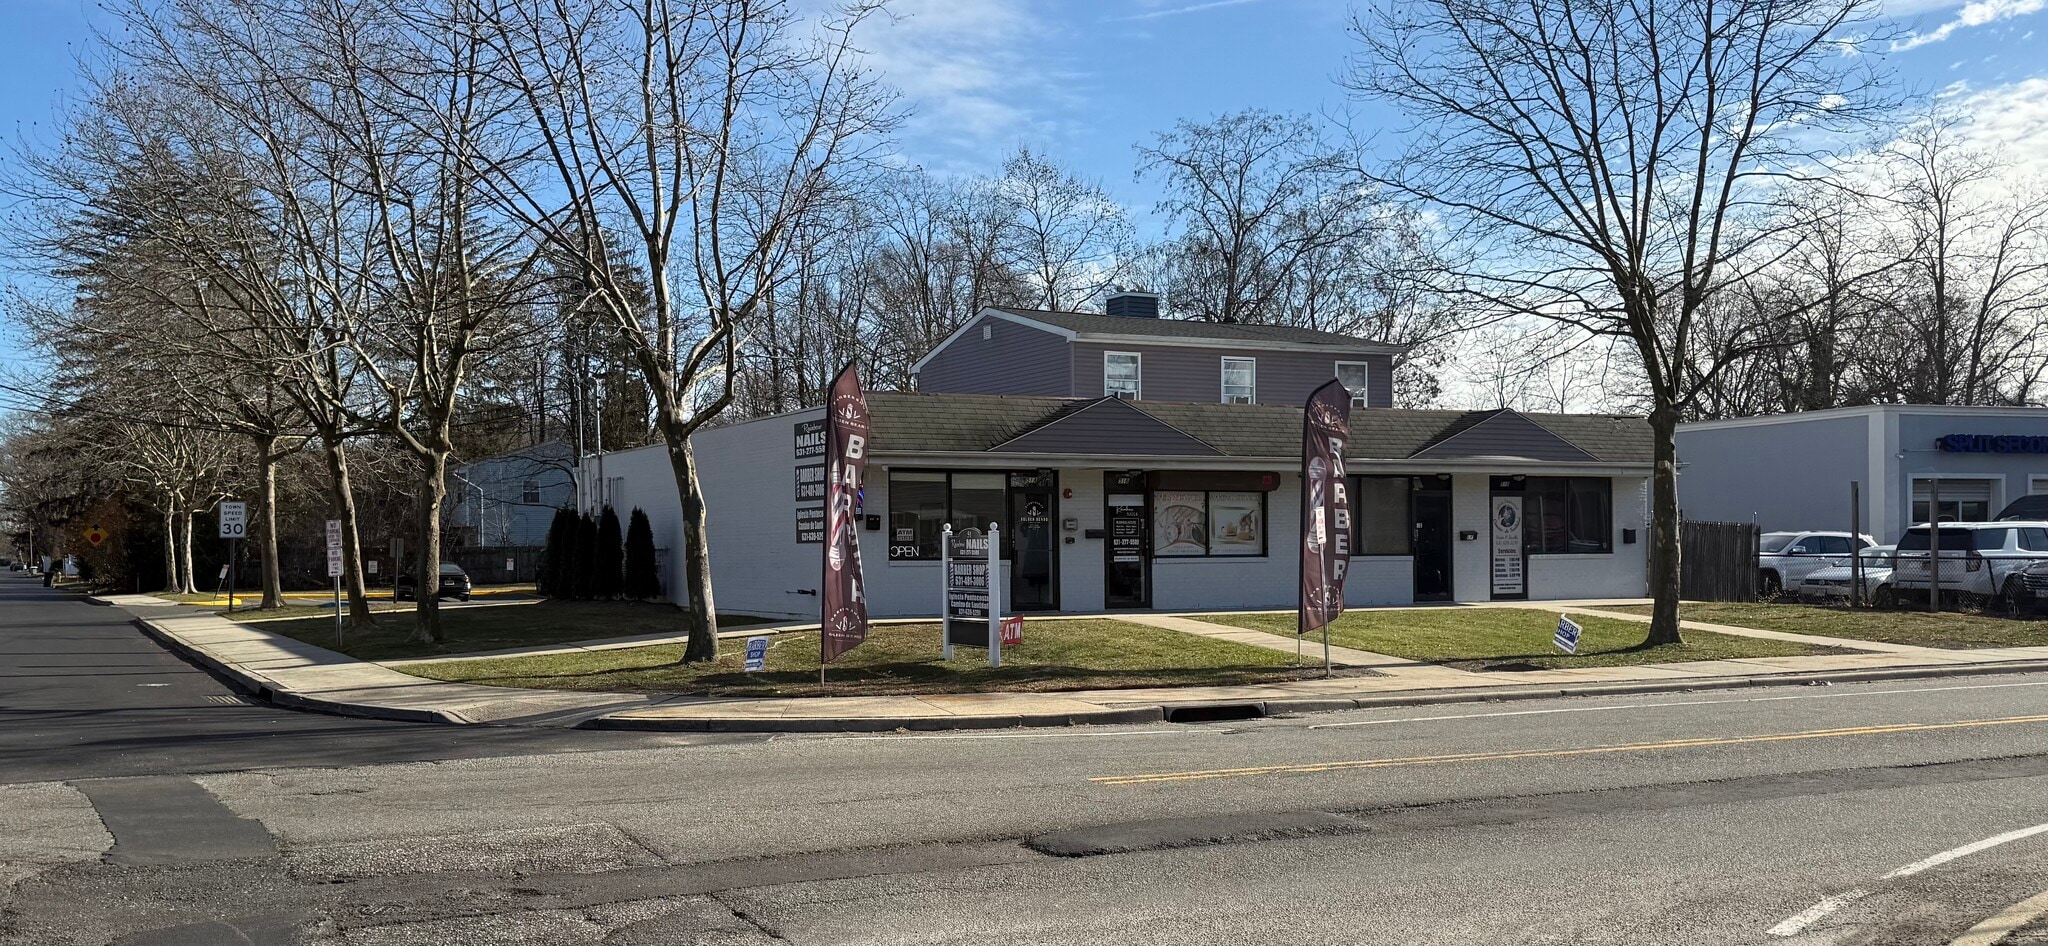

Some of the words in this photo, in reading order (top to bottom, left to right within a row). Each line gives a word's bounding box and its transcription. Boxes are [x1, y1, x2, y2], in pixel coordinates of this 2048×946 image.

[796, 431, 826, 448] NAILS
[1945, 434, 1992, 452] SPLIT
[796, 445, 825, 457] 631-277-558
[222, 523, 243, 535] 30
[966, 538, 988, 550] NAILS
[891, 545, 919, 557] OPEN
[973, 564, 985, 576] SHOP
[1003, 622, 1021, 641] ATM
[1560, 619, 1578, 637] RBER
